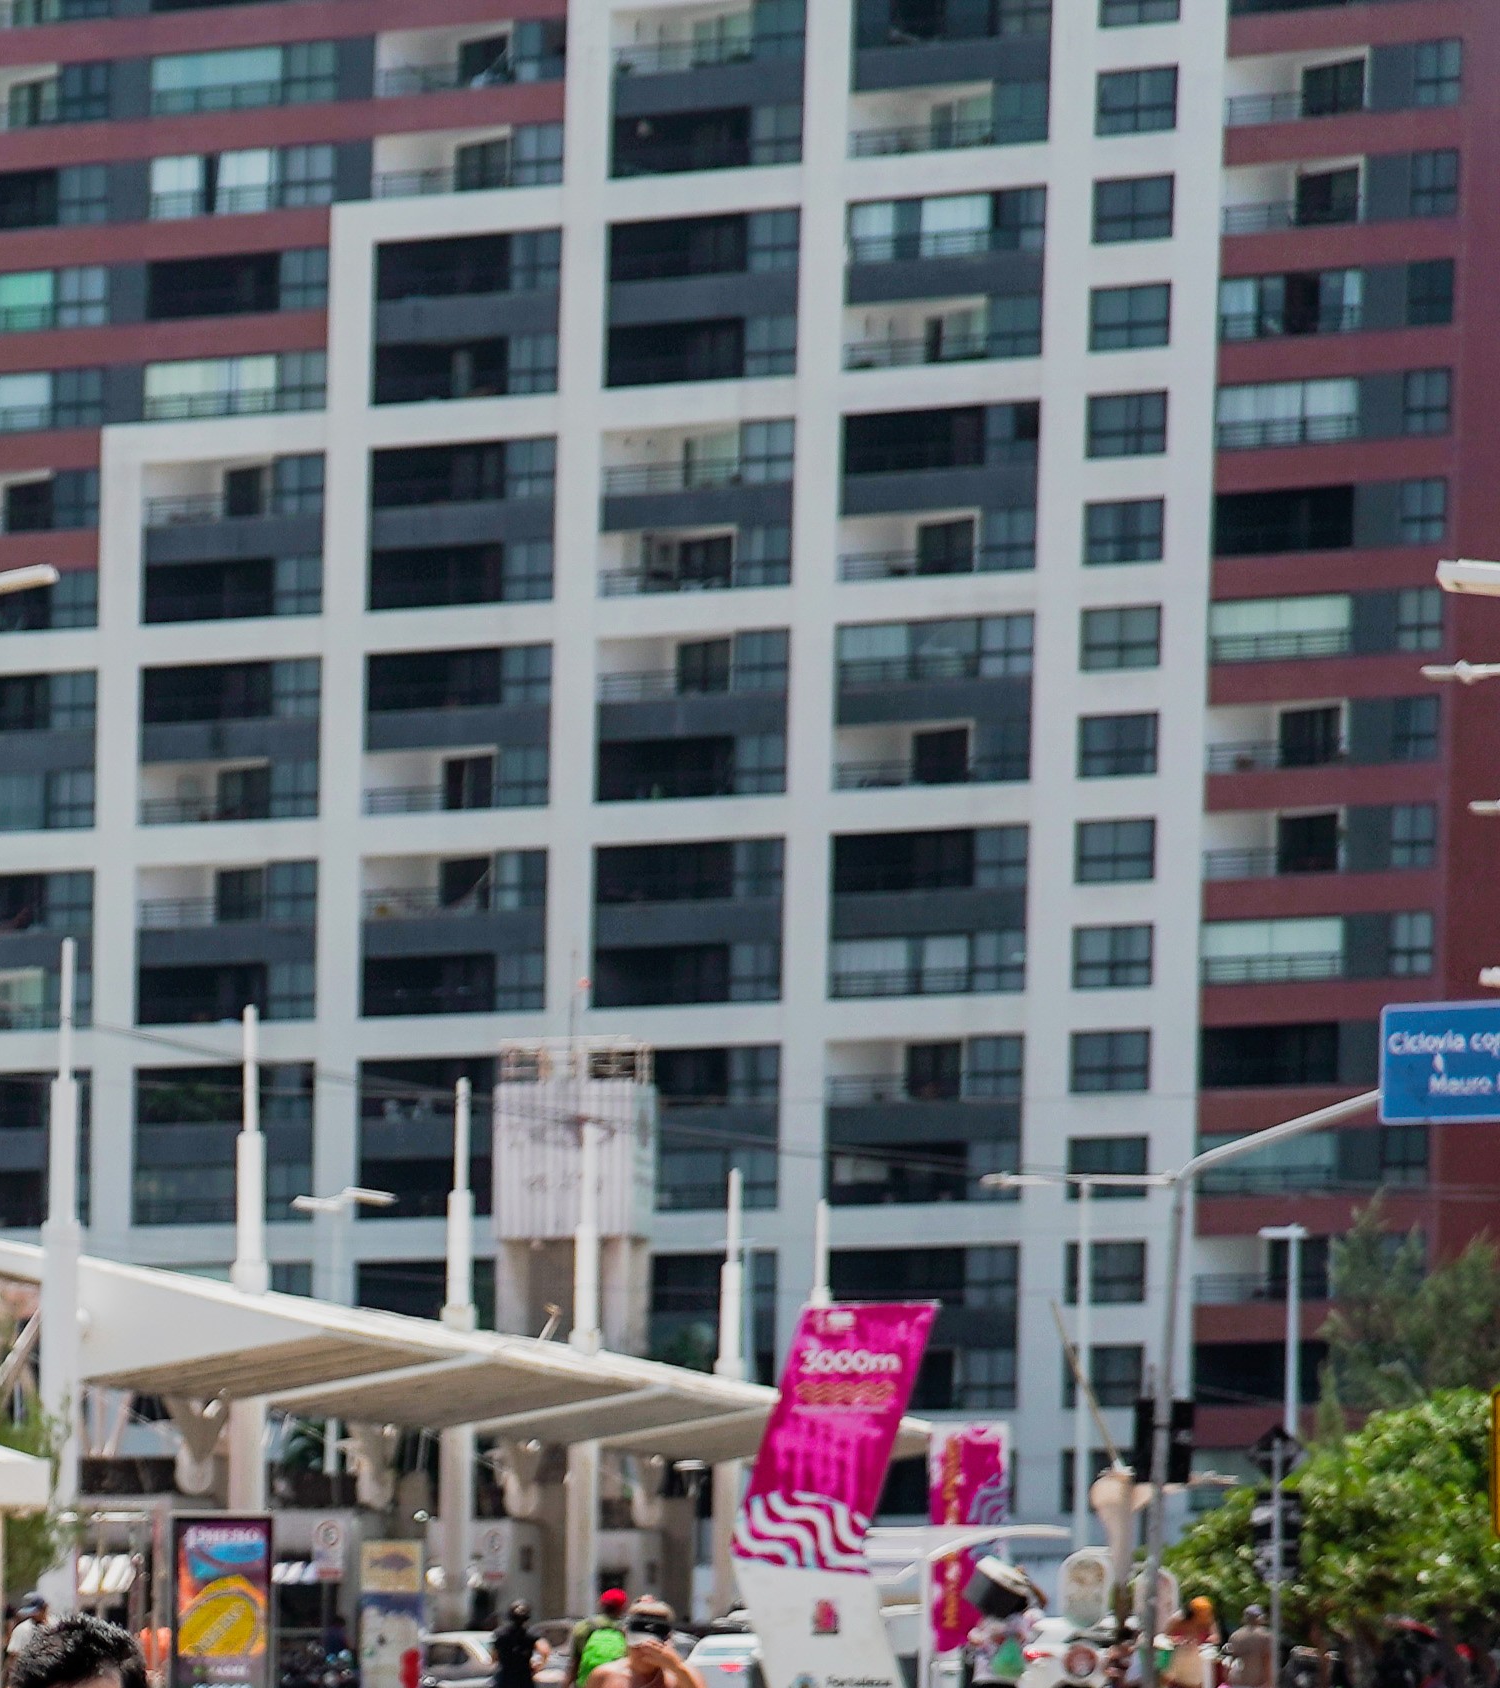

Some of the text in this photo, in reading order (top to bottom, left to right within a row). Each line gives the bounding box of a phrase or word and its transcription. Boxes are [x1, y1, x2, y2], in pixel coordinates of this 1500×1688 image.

[1388, 1030, 1466, 1055] Ciclovia
[1429, 1074, 1492, 1096] Mauro
[799, 1347, 902, 1376] 3000m
